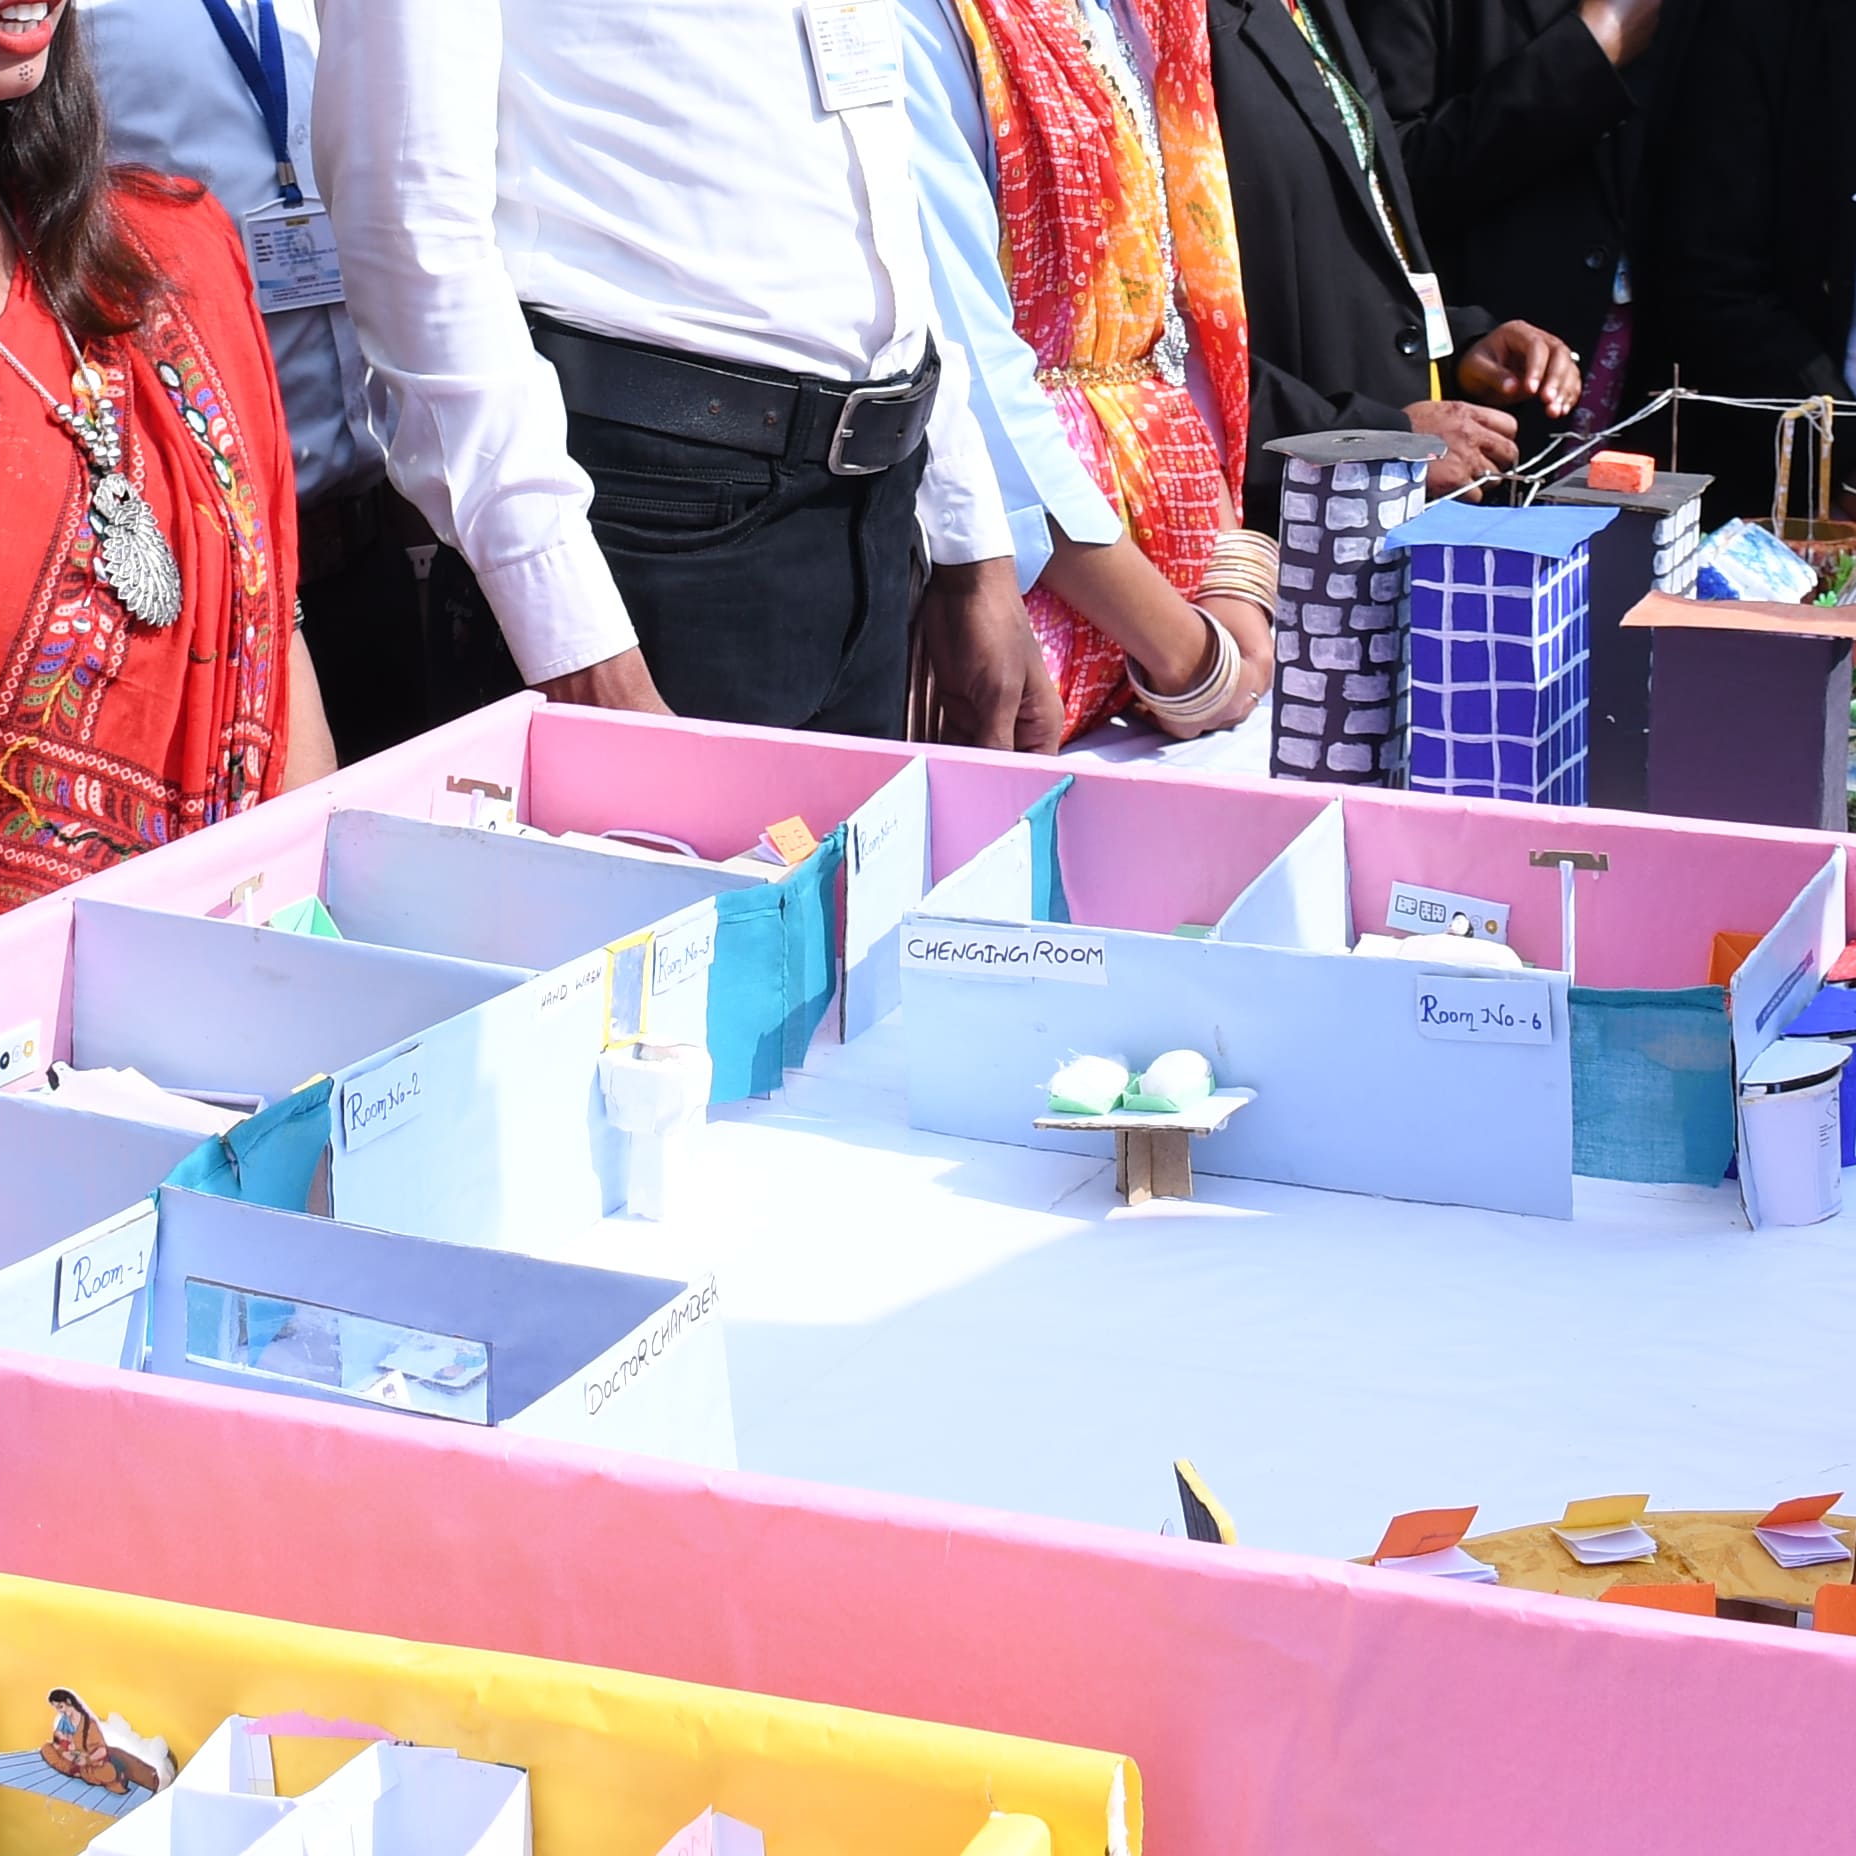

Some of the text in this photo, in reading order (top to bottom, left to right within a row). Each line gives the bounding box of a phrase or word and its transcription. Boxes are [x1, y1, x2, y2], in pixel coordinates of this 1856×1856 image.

[907, 939, 1029, 964] CHENGING
[540, 984, 568, 1010] HAND
[588, 1274, 721, 1416] DOCTOR CHAMBER
